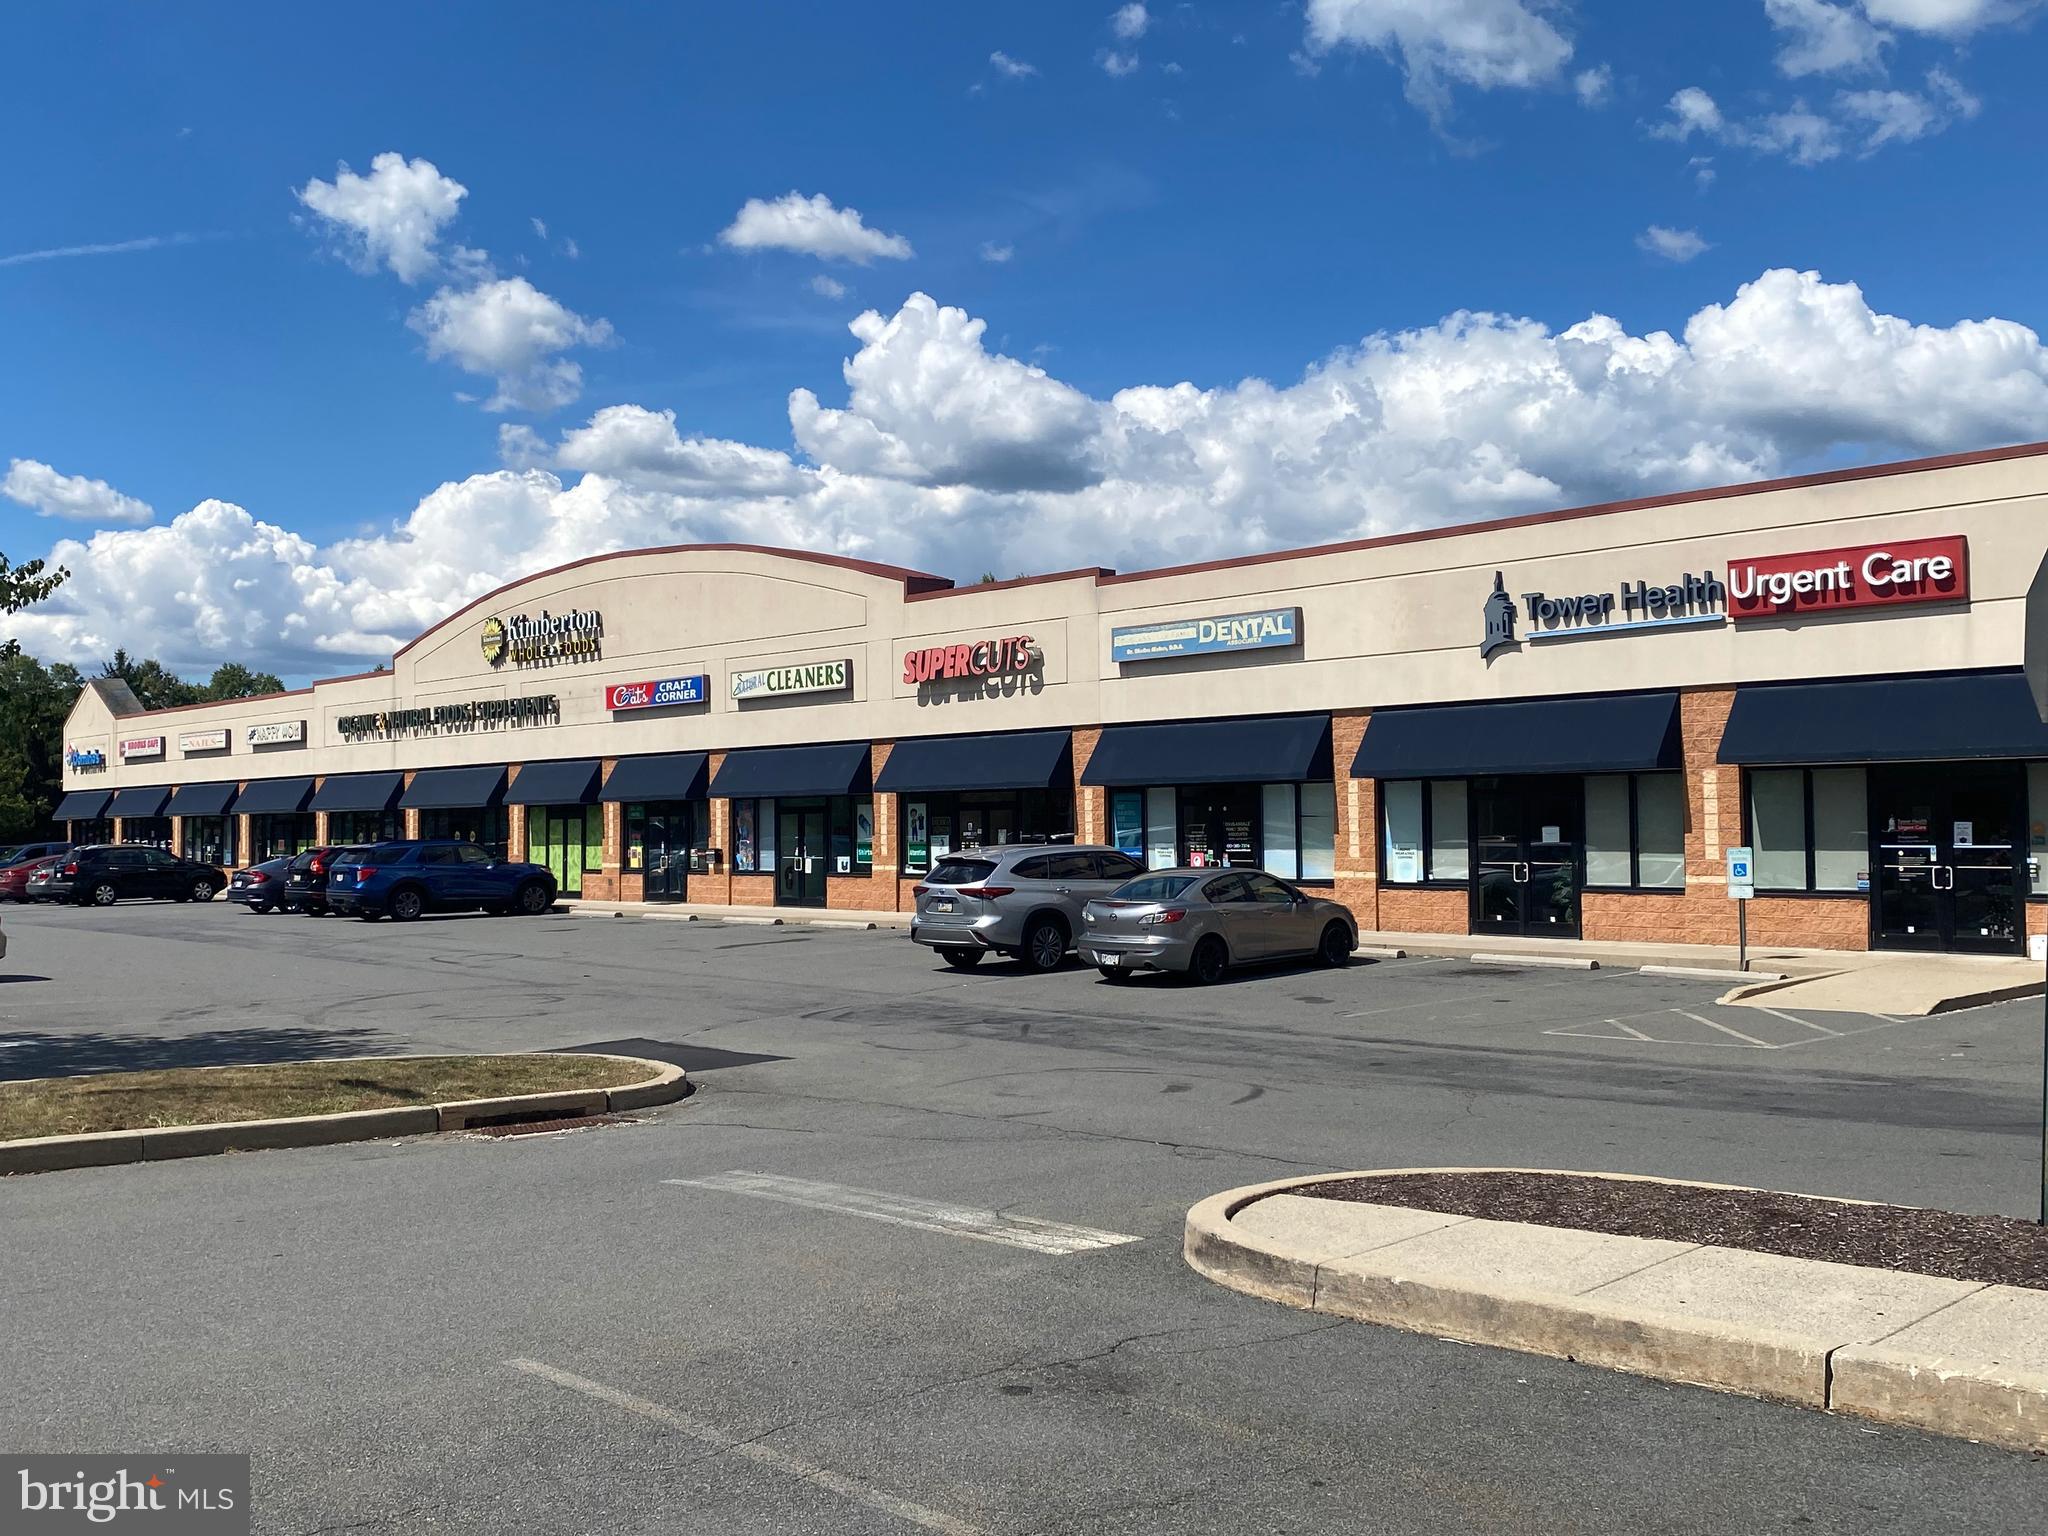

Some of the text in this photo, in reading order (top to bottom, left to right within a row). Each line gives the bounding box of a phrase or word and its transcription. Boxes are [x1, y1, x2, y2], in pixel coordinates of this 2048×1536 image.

[1729, 551, 1954, 604] Urgent Care
[1521, 571, 1724, 620] Tower Health
[507, 610, 598, 641] Kimberton
[1198, 615, 1293, 644] DENTAL
[510, 639, 596, 661] WHOLE FOODS
[903, 635, 1032, 685] SUPERCUTS
[659, 679, 692, 692] CRAFT
[766, 663, 845, 692] CLEANERS
[613, 685, 649, 706] Cat's
[655, 689, 697, 703] CORNER
[338, 694, 557, 733] ORGANIC & NATURAL FOODS SUPPLEMENTS
[188, 738, 217, 748] NAILS
